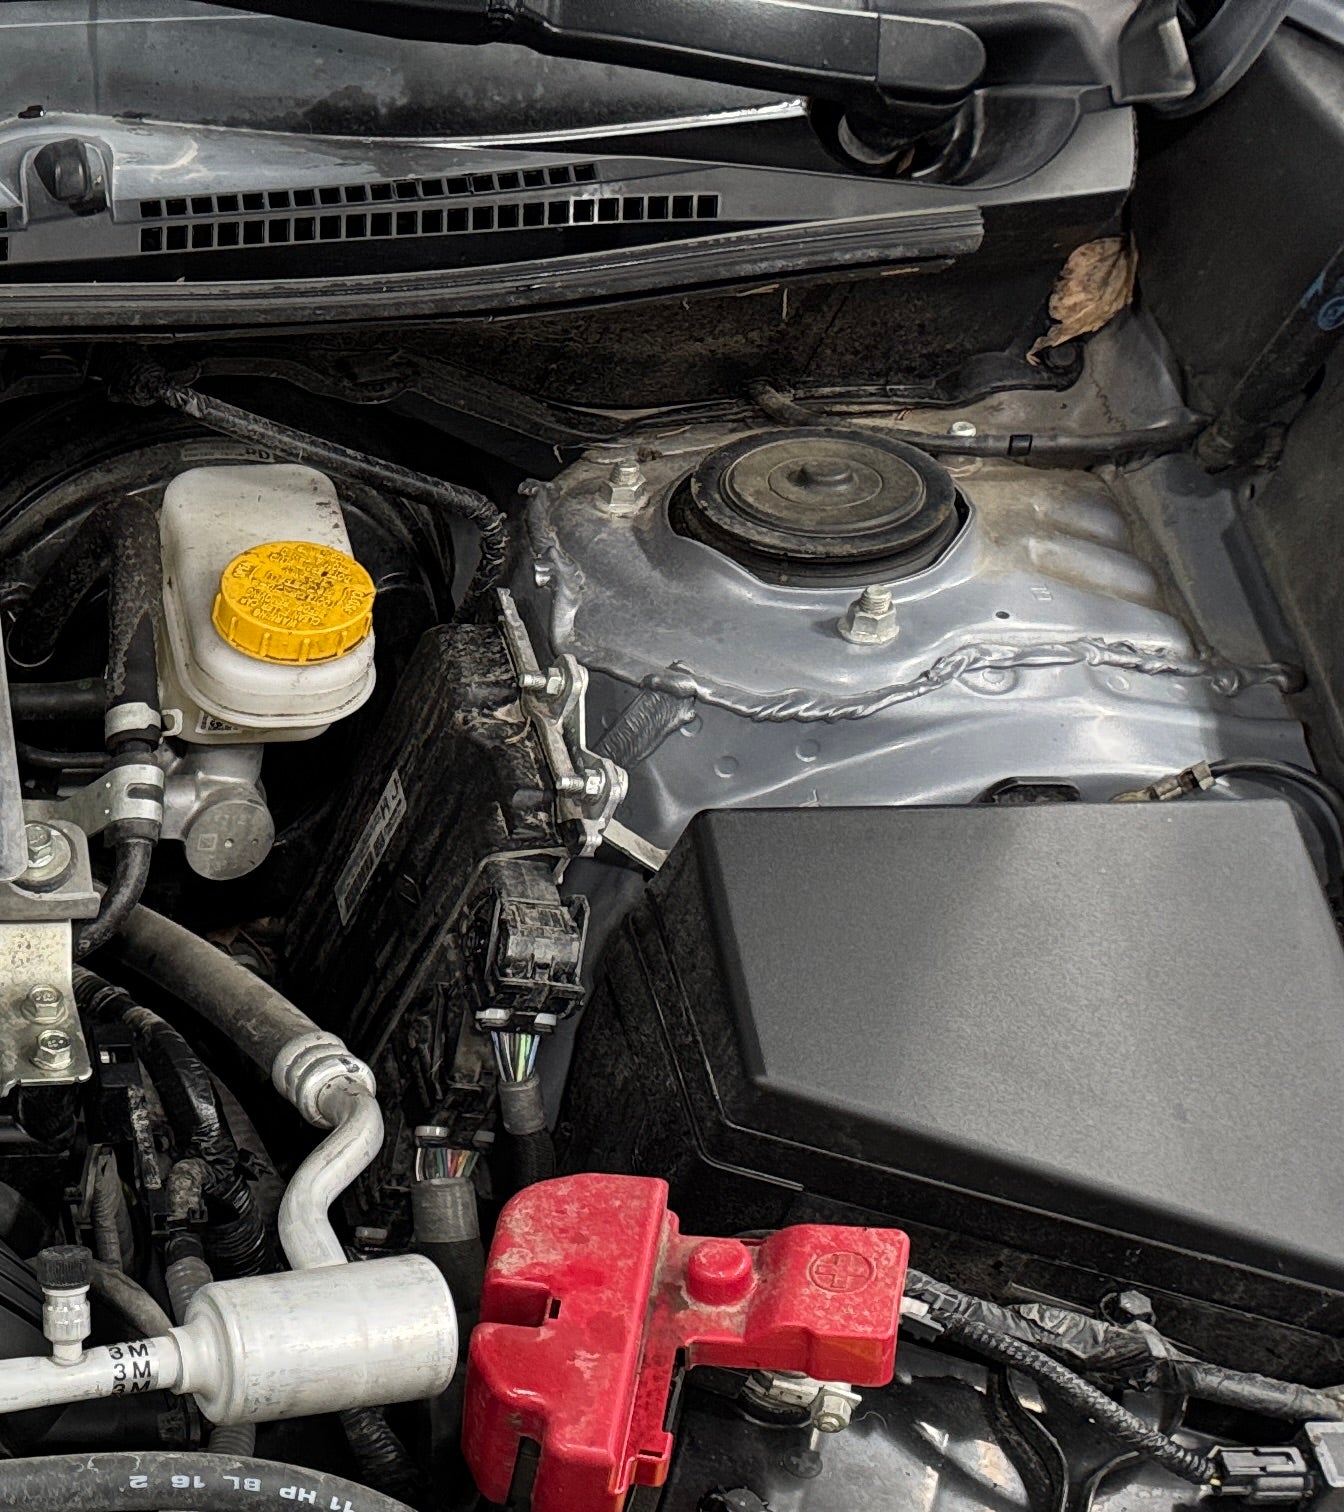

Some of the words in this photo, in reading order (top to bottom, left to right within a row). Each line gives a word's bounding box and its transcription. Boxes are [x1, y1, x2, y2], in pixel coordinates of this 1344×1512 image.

[128, 1474, 148, 1489] 2
[171, 1474, 206, 1489] 16
[222, 1475, 261, 1493] BL
[278, 1485, 317, 1506] HP
